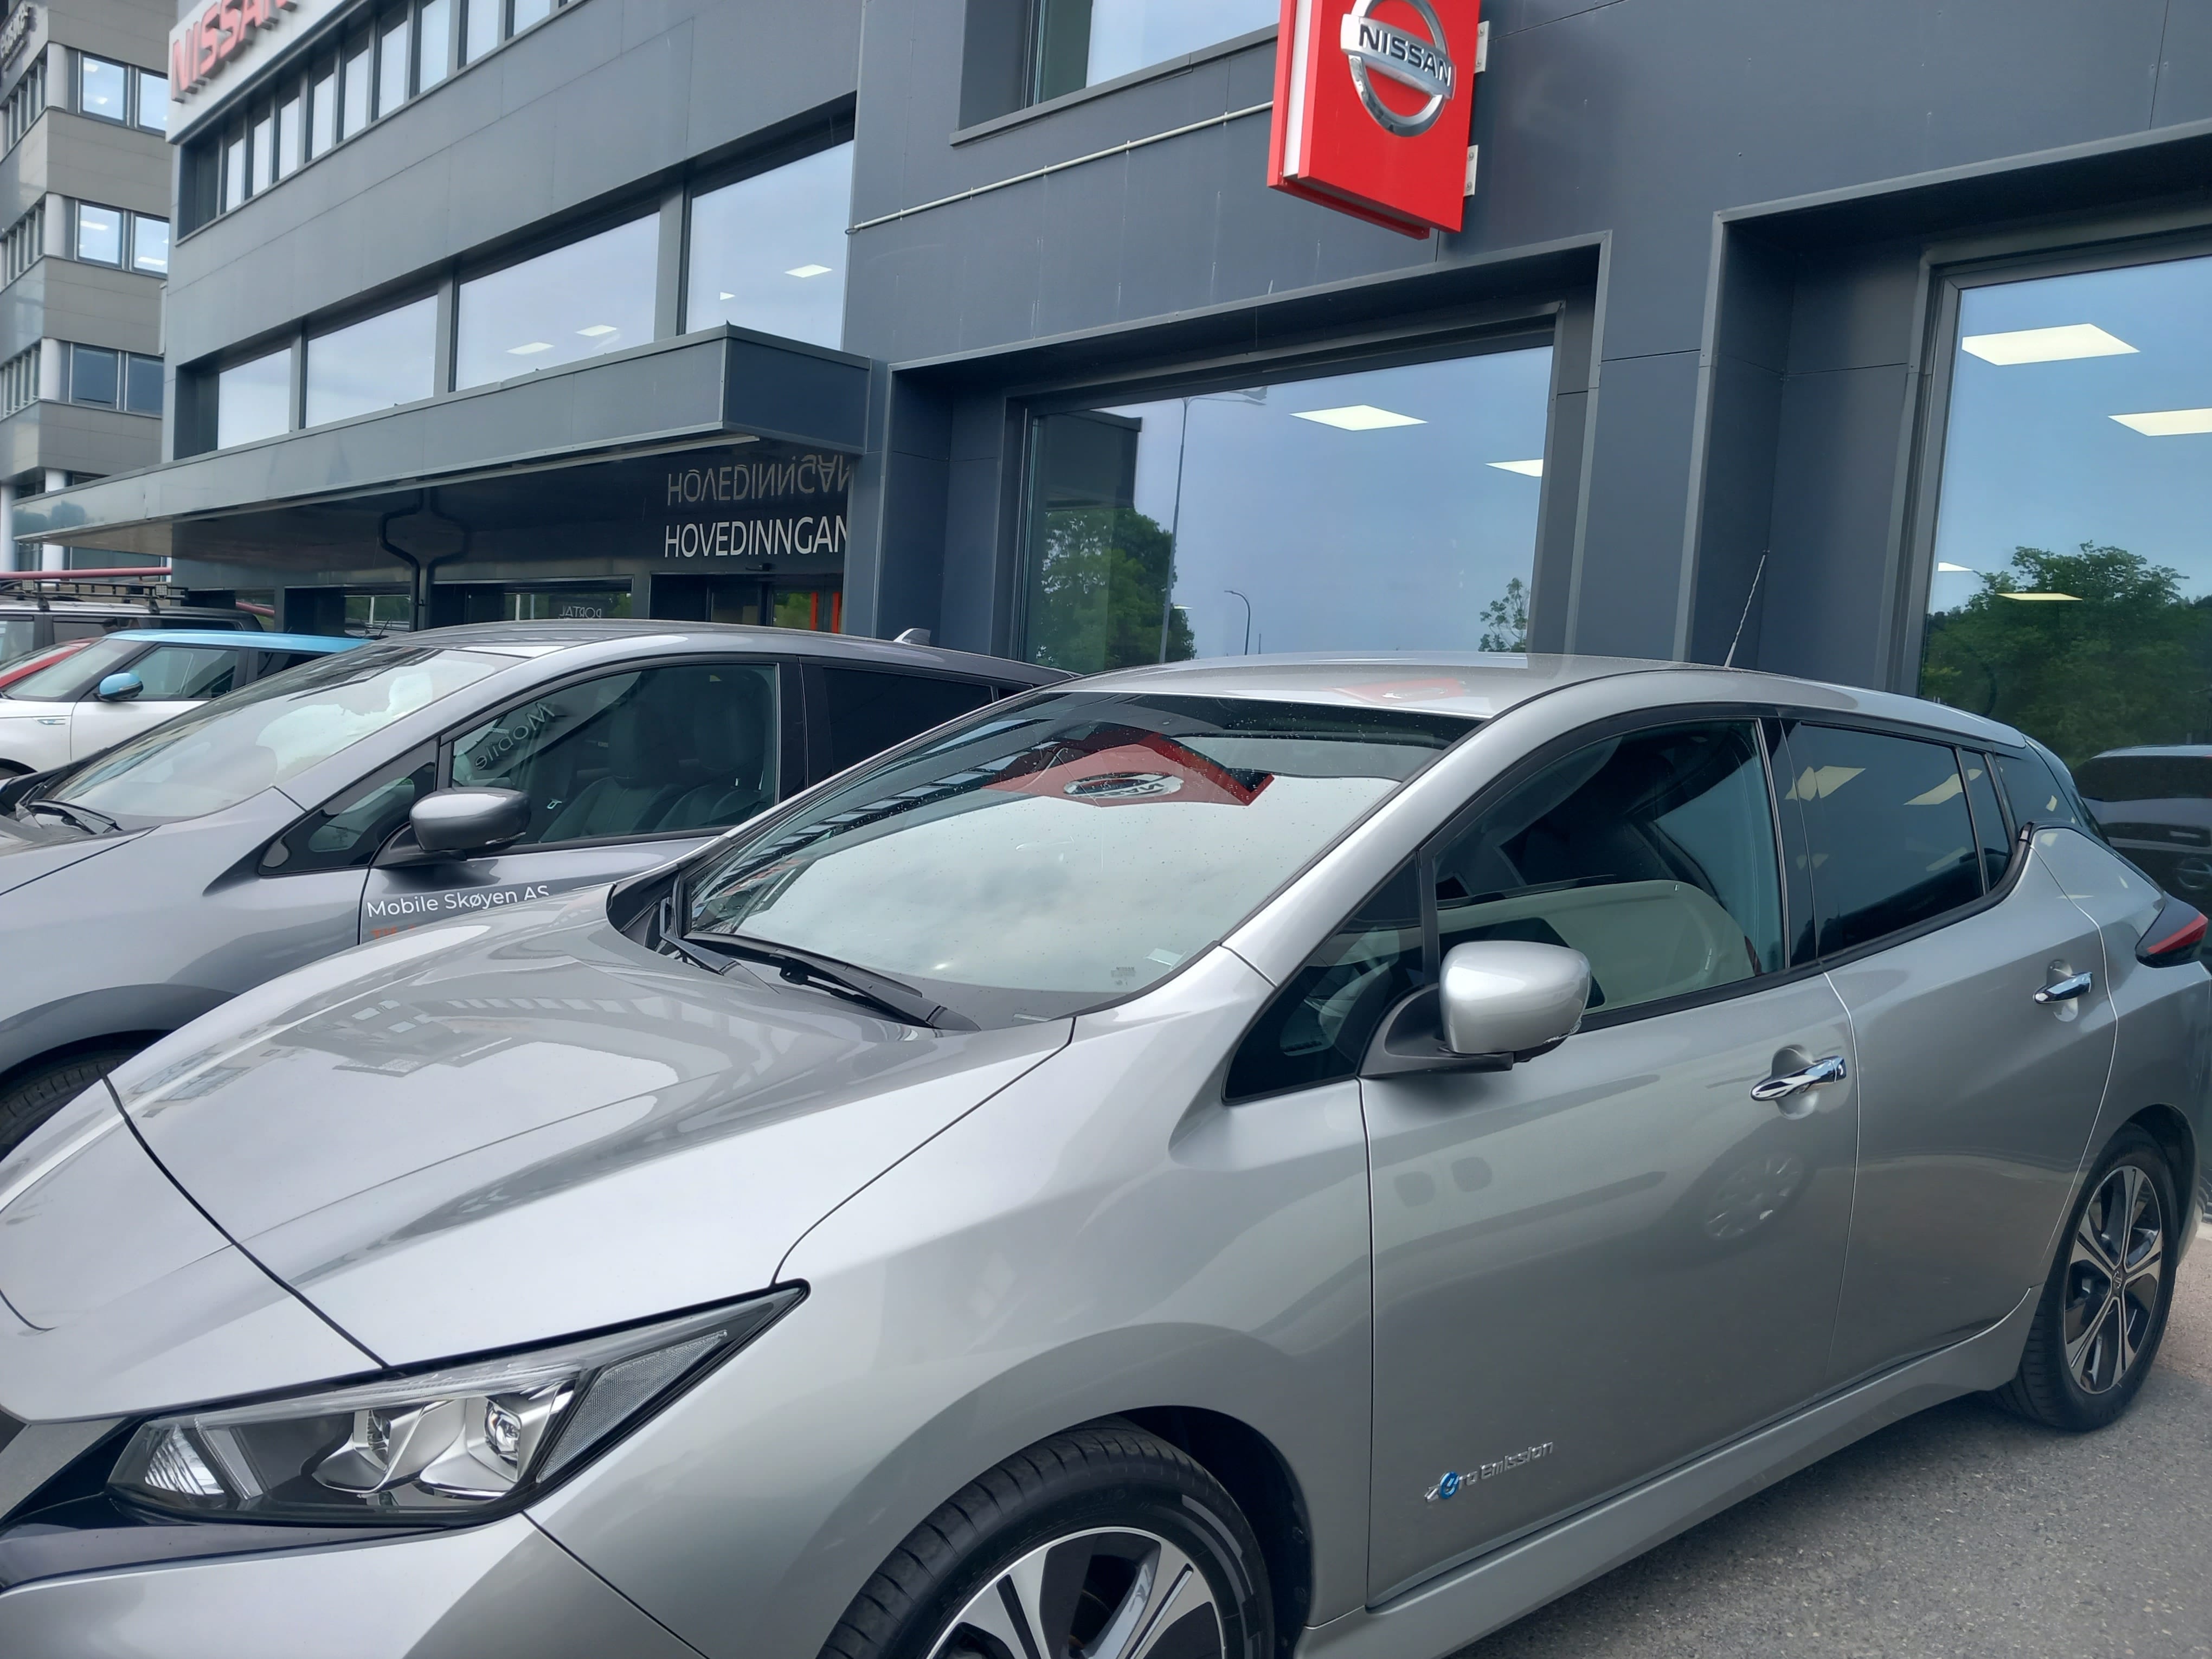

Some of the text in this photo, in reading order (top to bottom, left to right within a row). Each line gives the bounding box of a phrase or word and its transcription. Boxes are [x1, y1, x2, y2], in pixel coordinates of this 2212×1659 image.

[1359, 24, 1452, 87] NISSAN
[366, 885, 549, 918] Mobile Skøyen AS
[1480, 1441, 1553, 1480] Emission
